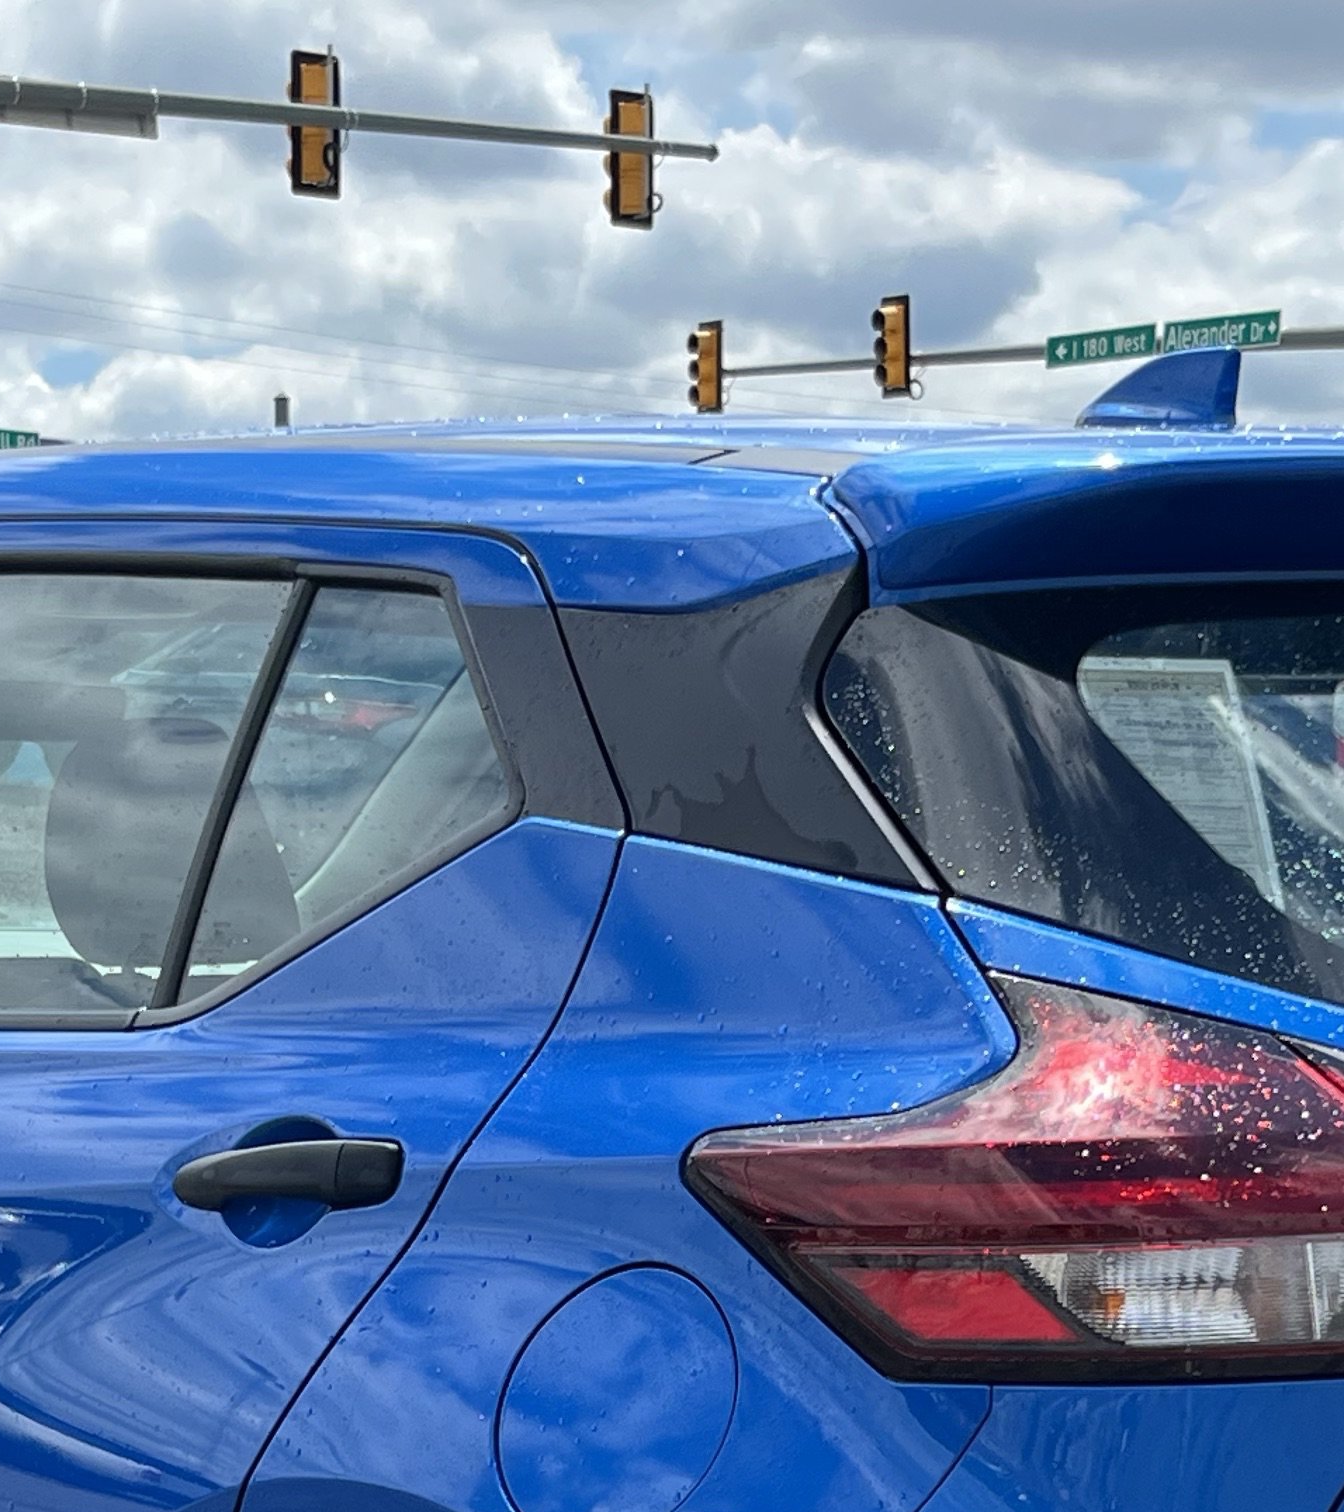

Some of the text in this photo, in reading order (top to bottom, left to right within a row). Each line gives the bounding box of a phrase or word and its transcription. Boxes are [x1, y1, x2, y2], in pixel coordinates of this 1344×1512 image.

[1083, 337, 1107, 358] 180
[1114, 333, 1146, 353] West
[1165, 321, 1266, 351] Alexander Dr
[17, 434, 35, 449] Rd
